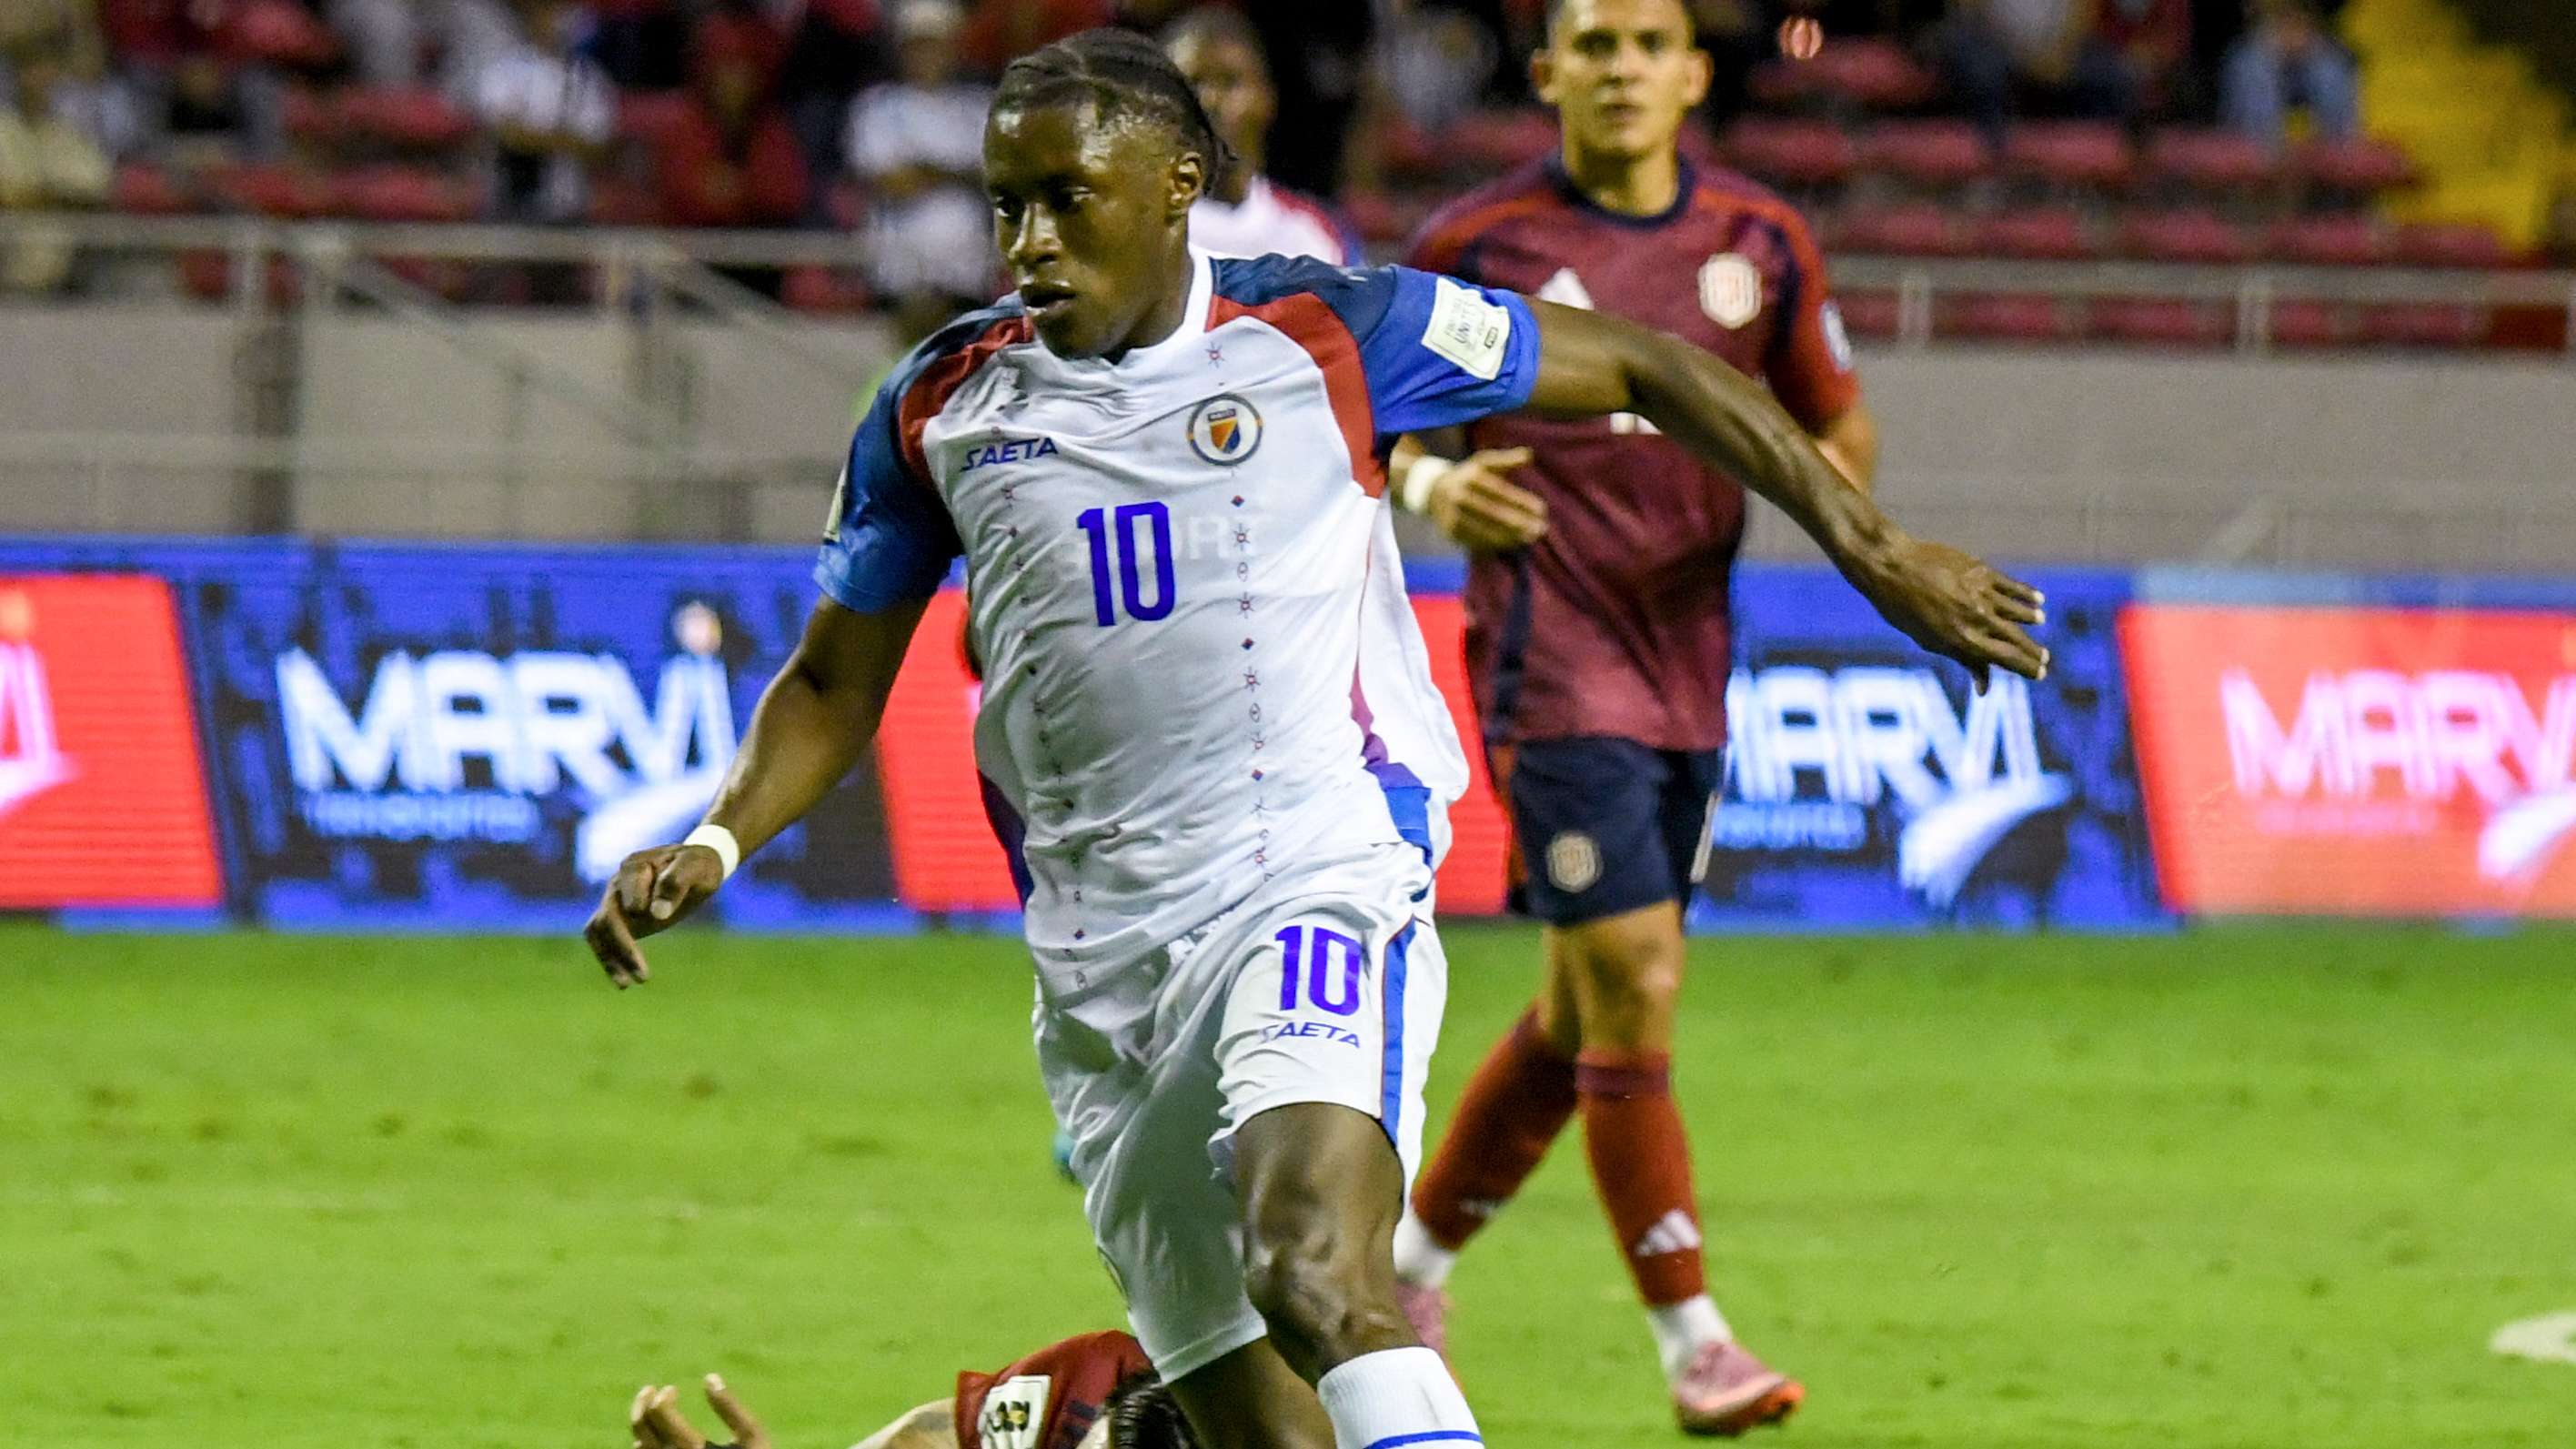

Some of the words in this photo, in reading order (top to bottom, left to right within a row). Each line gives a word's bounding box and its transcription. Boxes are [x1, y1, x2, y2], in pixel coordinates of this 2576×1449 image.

[960, 437, 1059, 472] SAETA
[1076, 500, 1177, 628] 10
[1274, 924, 1363, 1017] 10
